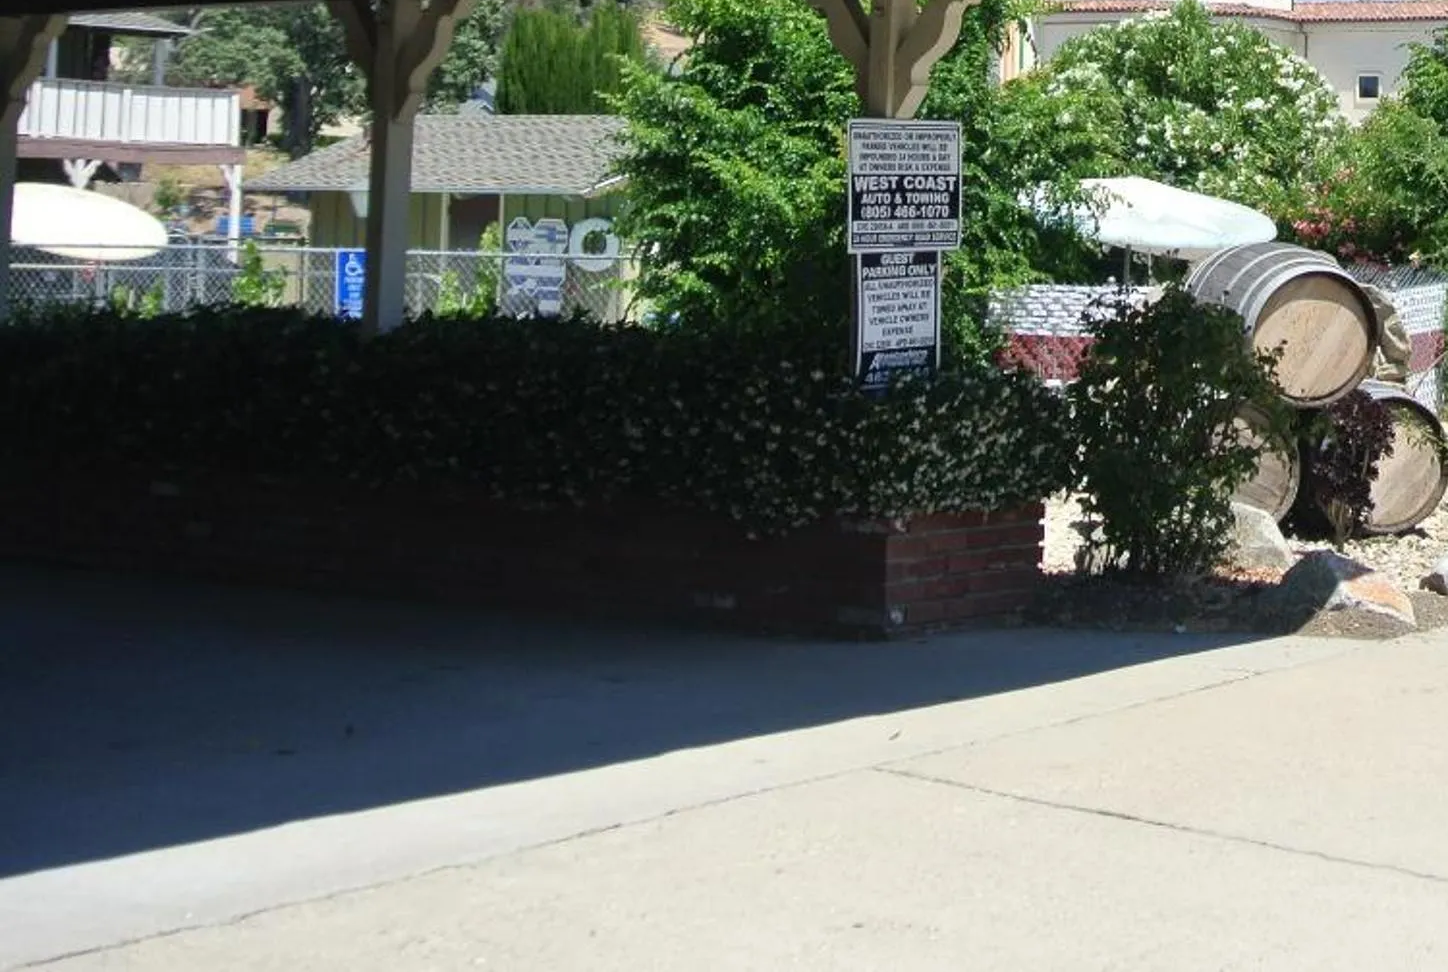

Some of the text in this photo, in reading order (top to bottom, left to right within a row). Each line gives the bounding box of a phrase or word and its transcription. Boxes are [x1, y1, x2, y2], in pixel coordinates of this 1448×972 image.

[854, 176, 957, 193] WEST COAST
[860, 192, 951, 205] AUTO & TOWING
[861, 206, 891, 219] (805)
[880, 253, 915, 265] GUEST
[863, 263, 937, 278] PARKING ONLY
